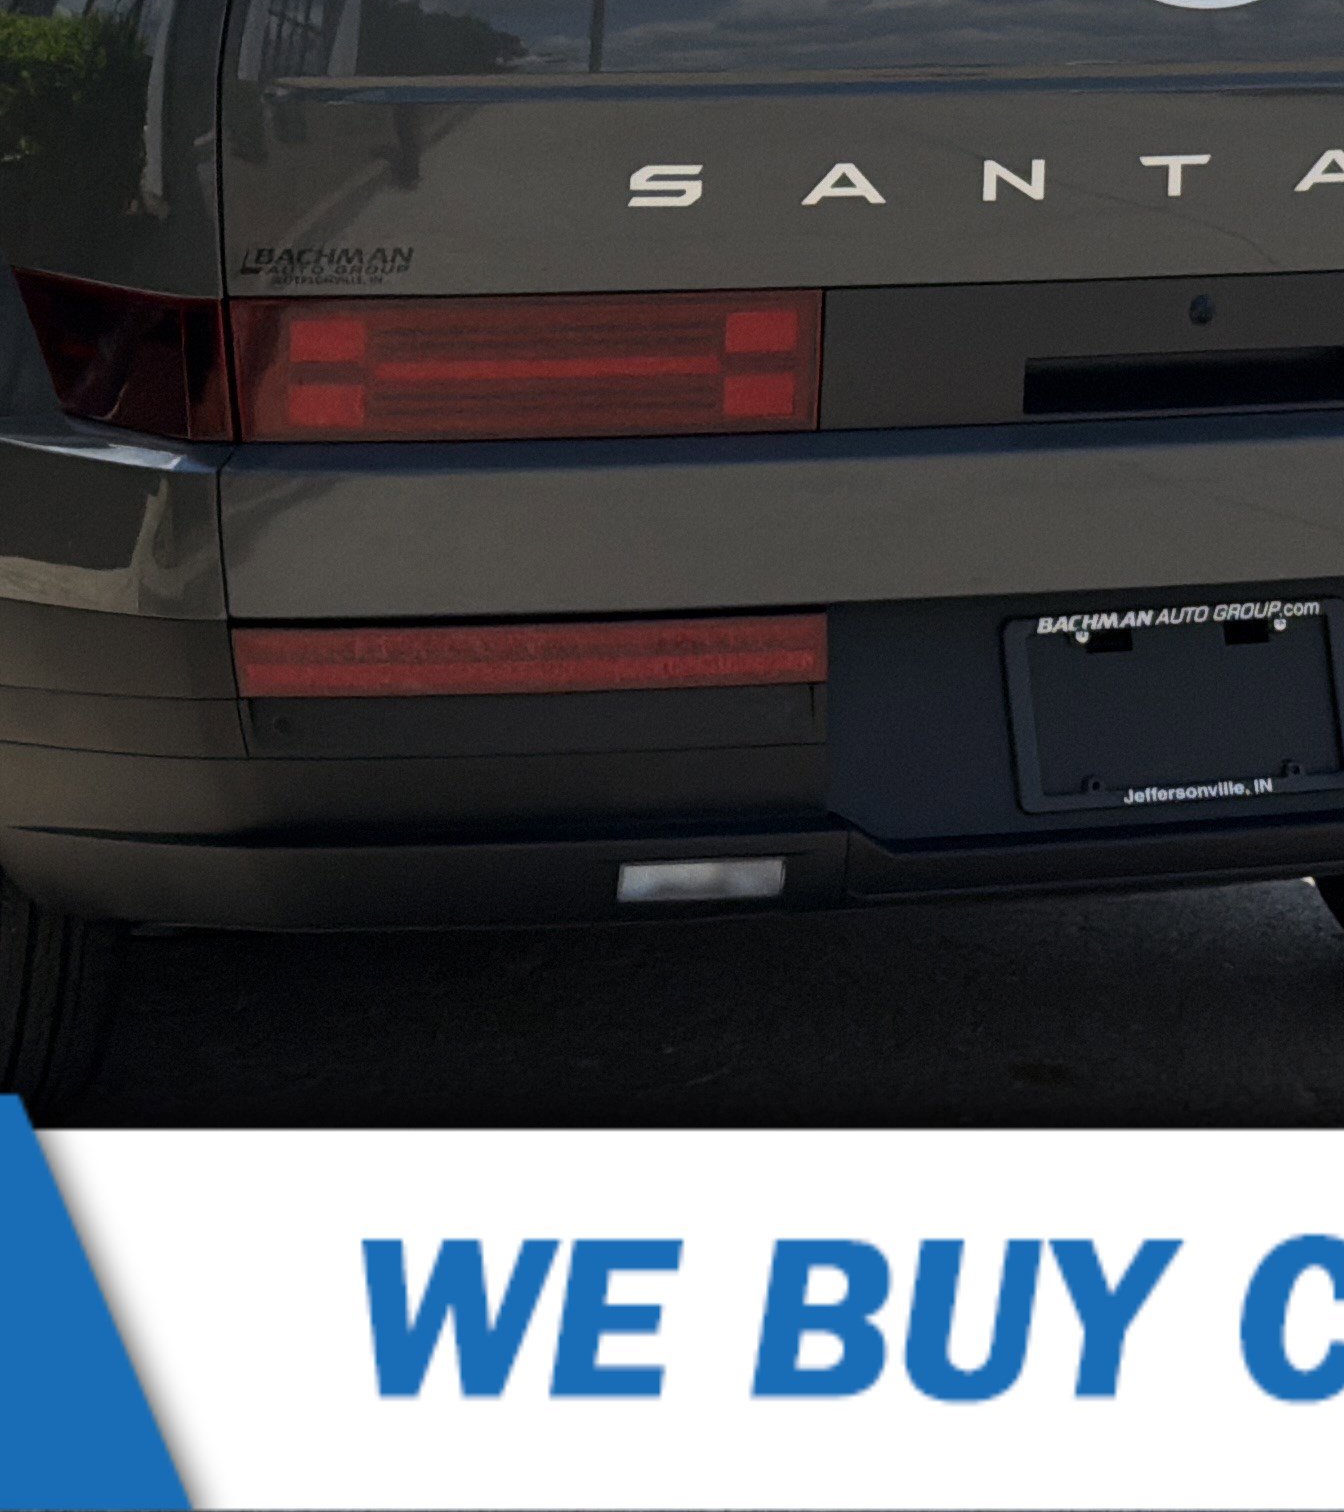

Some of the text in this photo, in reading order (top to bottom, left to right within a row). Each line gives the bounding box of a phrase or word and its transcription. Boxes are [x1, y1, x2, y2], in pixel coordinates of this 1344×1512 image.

[255, 247, 414, 265] BACHMAN
[1037, 601, 1320, 634] BACHMAN AUTO GROUP.com
[1254, 778, 1274, 794] IN
